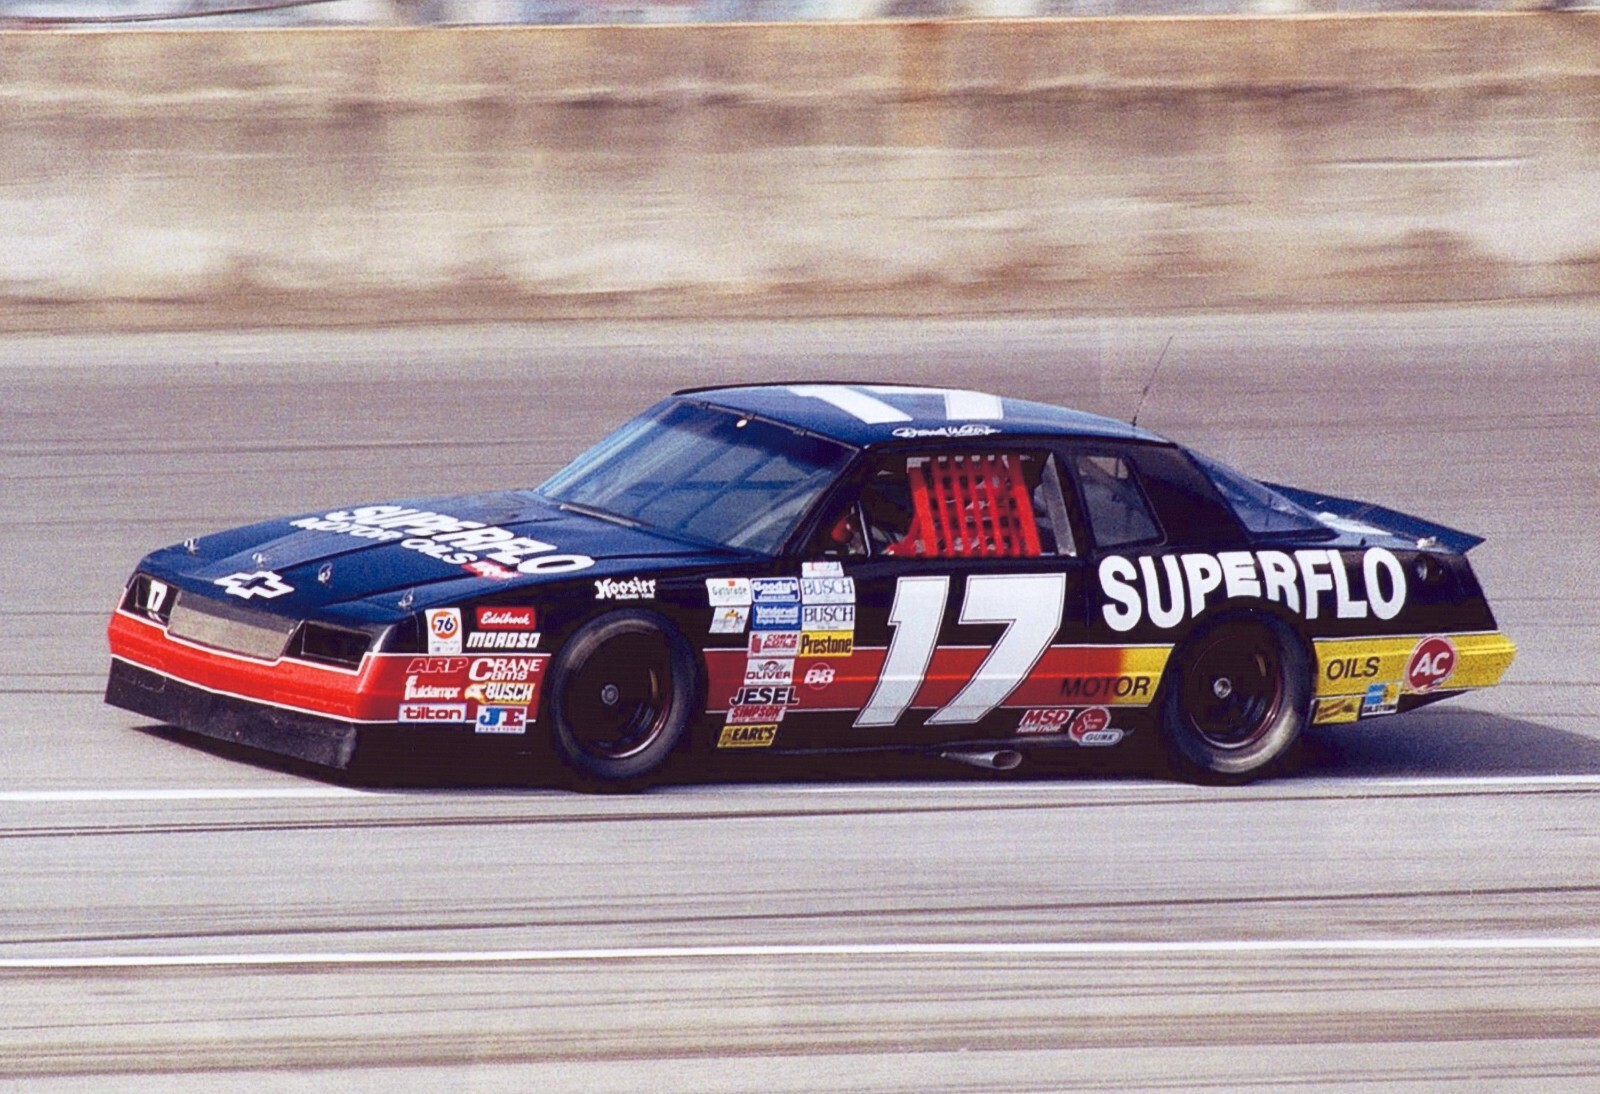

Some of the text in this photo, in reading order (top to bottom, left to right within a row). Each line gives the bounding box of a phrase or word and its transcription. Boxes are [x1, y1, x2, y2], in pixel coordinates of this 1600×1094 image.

[401, 538, 478, 566] OILS
[803, 579, 853, 596] BUSCH
[1098, 547, 1407, 632] SUPERFLO
[480, 611, 530, 625] Edelbrock
[804, 606, 853, 623] BUSCH
[434, 618, 454, 632] 76
[466, 632, 541, 648] MOROSO
[800, 633, 852, 655] Prestone
[852, 572, 1067, 728] 17
[405, 657, 469, 673] ARP
[468, 658, 542, 681] CRANE
[1326, 656, 1380, 681] OILS
[1411, 651, 1450, 677] AC
[746, 671, 792, 680] OLIVER
[485, 682, 534, 703] BUSCH
[730, 686, 799, 705] JESEL
[1060, 675, 1151, 698] MOTOR
[479, 707, 525, 727] JE
[732, 706, 781, 718] SIMPSON
[1021, 709, 1073, 725] MSD
[732, 727, 776, 742] EARL'S
